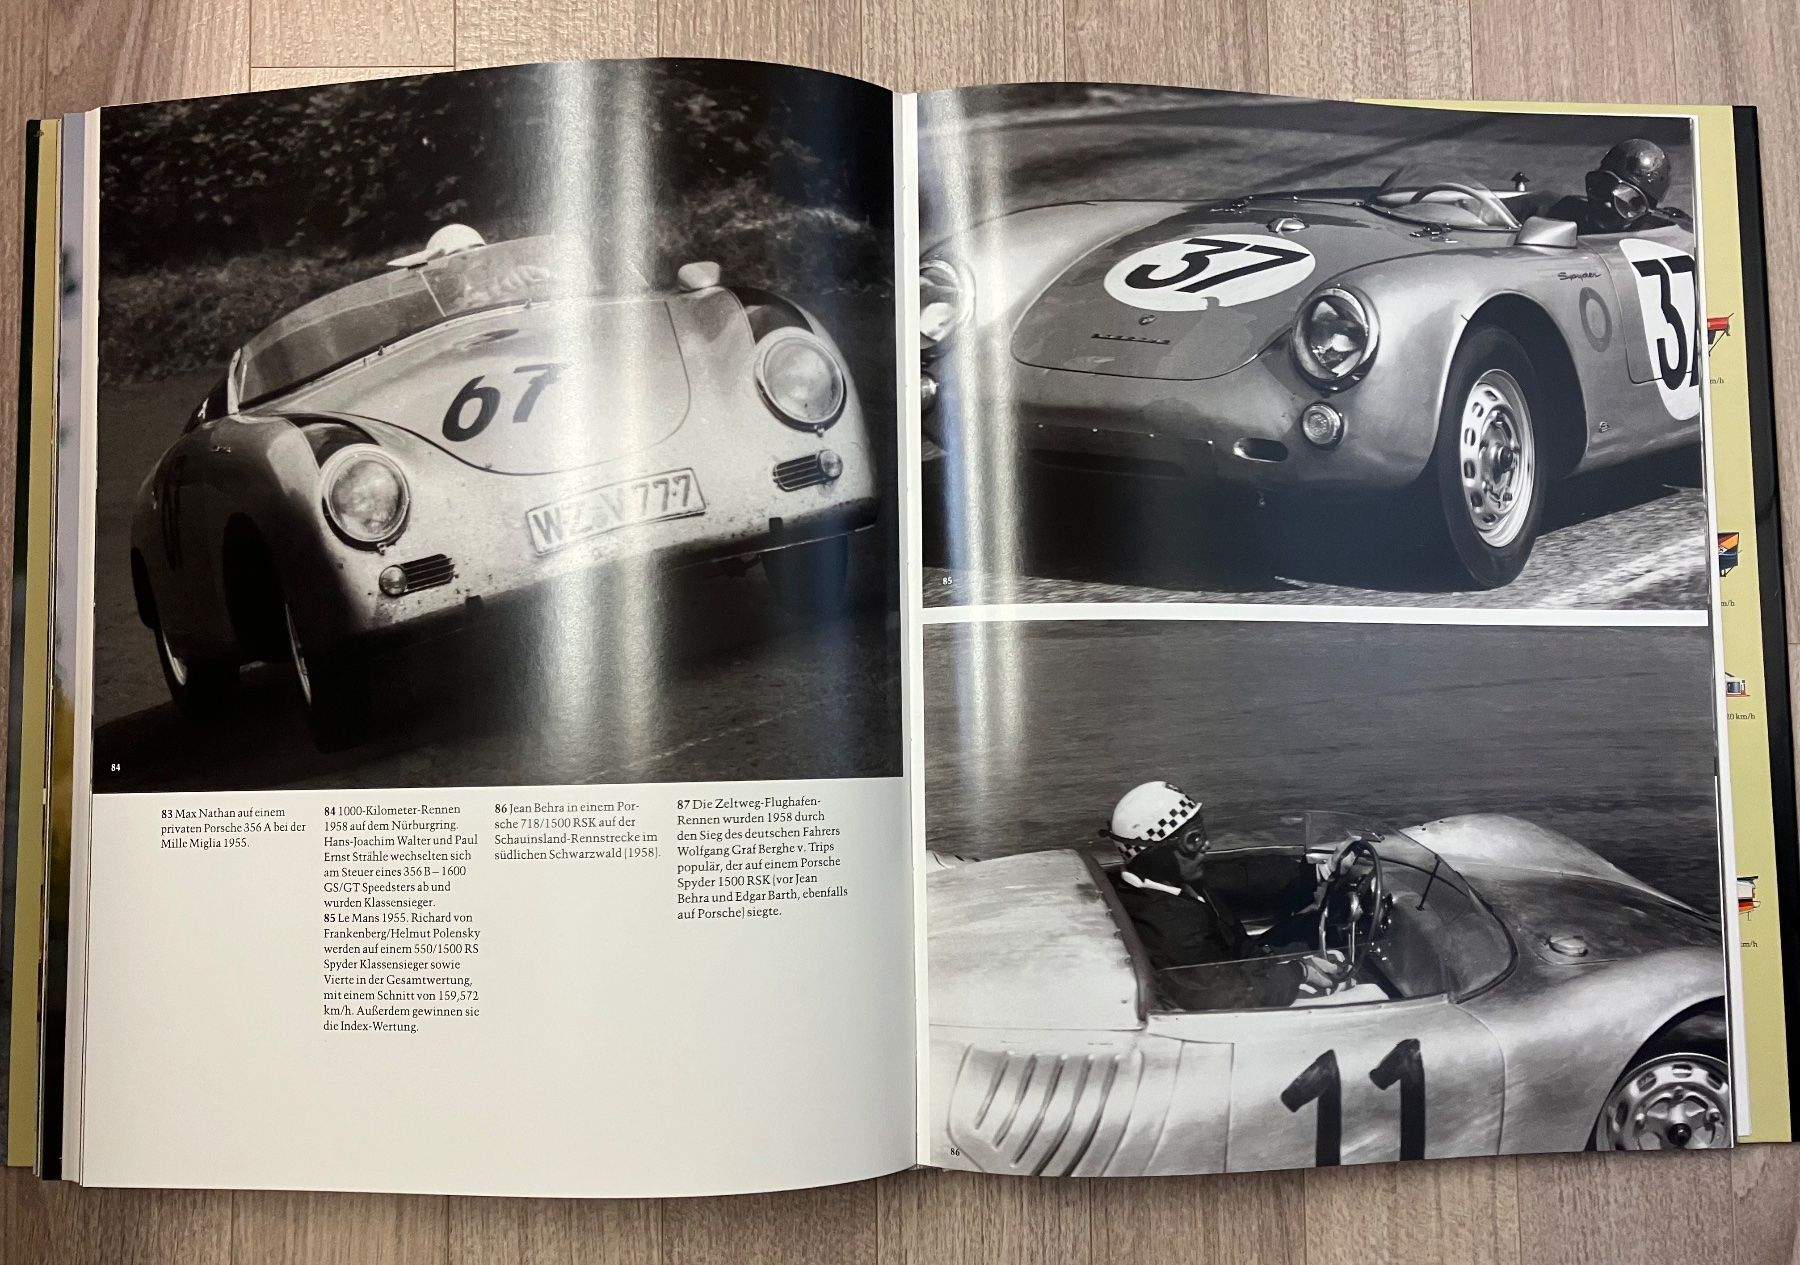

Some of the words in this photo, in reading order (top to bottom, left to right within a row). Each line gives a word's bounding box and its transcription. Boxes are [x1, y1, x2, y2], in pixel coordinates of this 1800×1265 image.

[1125, 238, 1310, 293] 37
[1558, 271, 1602, 282] Spyder
[1632, 255, 1699, 390] 37
[1710, 376, 1725, 384] m/h
[442, 364, 567, 442] 67
[633, 475, 690, 516] 777
[942, 576, 953, 585] 85
[1720, 599, 1735, 607] m/h
[1735, 712, 1756, 720] km/h
[111, 763, 121, 772] 84
[495, 804, 507, 813] 86
[510, 804, 531, 815] Jean
[534, 802, 564, 812] Behra
[567, 803, 577, 812] in
[581, 802, 614, 812] einem
[617, 802, 639, 811] Por-
[678, 800, 690, 809] 87
[692, 800, 712, 809] Die
[715, 796, 820, 810] Zeltweg-Flughafen-
[162, 810, 172, 818] 83
[175, 810, 196, 818] Max
[199, 808, 235, 818] Nathan
[238, 808, 252, 817] auf
[255, 808, 285, 816] einem
[325, 807, 335, 816] 84
[340, 805, 460, 815] 1000-Kilometer-Rennen
[495, 819, 518, 828] sche
[521, 818, 571, 828] 718/1500
[573, 818, 596, 827] RSK
[599, 816, 616, 827] auf
[619, 816, 635, 826] der
[678, 816, 720, 825] Rennen
[723, 813, 764, 823] wurden
[768, 813, 792, 822] 1958
[795, 811, 824, 821] durch
[161, 825, 201, 836] privaten
[205, 823, 242, 832] Porsche
[244, 823, 261, 832] 356
[264, 823, 271, 831] A
[274, 822, 287, 831] bei
[291, 822, 306, 831] der
[325, 822, 347, 831] 1958
[350, 821, 365, 830] auf
[368, 821, 389, 830] dem
[392, 820, 458, 832] Nürburgring.
[495, 832, 640, 844] Schauinsland-Rennstrecke
[643, 832, 657, 841] im
[677, 831, 697, 840] den
[700, 831, 722, 842] Sieg
[725, 829, 742, 839] des
[745, 827, 800, 838] deutschen
[803, 826, 840, 836] Fahrers
[161, 838, 187, 848] Mille
[190, 838, 221, 850] Miglia
[225, 838, 249, 847] 1955.
[325, 836, 394, 847] Hans-Joachim
[398, 835, 431, 845] Walter
[433, 835, 452, 845] und
[456, 834, 477, 844] Paul
[325, 853, 350, 861] Ernst
[353, 851, 388, 861] Strähle
[391, 851, 448, 860] wechselten
[451, 850, 471, 860] sich
[495, 849, 546, 859] südlichen
[549, 848, 621, 859] Schwarzwald
[677, 846, 730, 858] Wolfgang
[732, 844, 756, 854] Graf
[759, 843, 795, 855] Berghe
[808, 842, 834, 853] Trips
[678, 861, 722, 874] populär,
[726, 860, 742, 870] der
[745, 859, 762, 870] auf
[765, 860, 798, 869] einem
[801, 856, 840, 867] Porsche
[342, 868, 373, 877] Steuer
[376, 867, 401, 876] eines
[404, 867, 422, 876] 356
[424, 867, 430, 876] B
[443, 866, 466, 875] 1600
[324, 883, 360, 892] GS/GT
[363, 882, 415, 894] Speedsters
[417, 882, 429, 891] ab
[431, 881, 450, 891] und
[678, 877, 715, 890] Spyder
[719, 876, 744, 886] 1500
[747, 875, 770, 885] RSK
[796, 874, 817, 885] Jean
[678, 893, 709, 903] Behra
[712, 892, 733, 902] und
[735, 891, 766, 903] Edgar
[768, 889, 800, 900] Barth,
[803, 886, 847, 898] ebenfalls
[324, 897, 361, 907] wurden
[365, 897, 435, 909] Klassensieger.
[324, 914, 335, 922] 85
[339, 914, 349, 922] Le
[352, 914, 379, 922] Mans
[383, 913, 408, 922] 1955.
[412, 912, 451, 922] Richard
[678, 908, 695, 919] auf
[747, 907, 781, 918] siegte.
[324, 928, 430, 940] Frankenberg/Helmut
[434, 928, 480, 940] Polensky
[324, 944, 360, 953] werden
[363, 943, 378, 953] auf
[381, 944, 412, 953] einem
[415, 944, 462, 953] 550/1500
[465, 944, 478, 953] RS
[324, 959, 357, 971] Spyder
[360, 959, 428, 971] Klassensieger
[431, 960, 460, 969] sowie
[324, 975, 354, 984] Vierte
[356, 975, 366, 984] in
[369, 974, 384, 984] der
[387, 975, 472, 987] Gesamtwertung,
[324, 991, 341, 999] mit
[344, 991, 374, 999] einem
[378, 990, 414, 1000] Schnitt
[440, 991, 478, 1002] 159,572
[324, 1005, 354, 1015] km/h.
[357, 1005, 409, 1015] Außerdem
[413, 1007, 462, 1018] gewinnen
[465, 1007, 479, 1016] sie
[324, 1020, 338, 1030] die
[341, 1021, 418, 1033] Index-Wertung.
[1280, 1038, 1425, 1168] 11
[950, 1147, 961, 1156] 86
